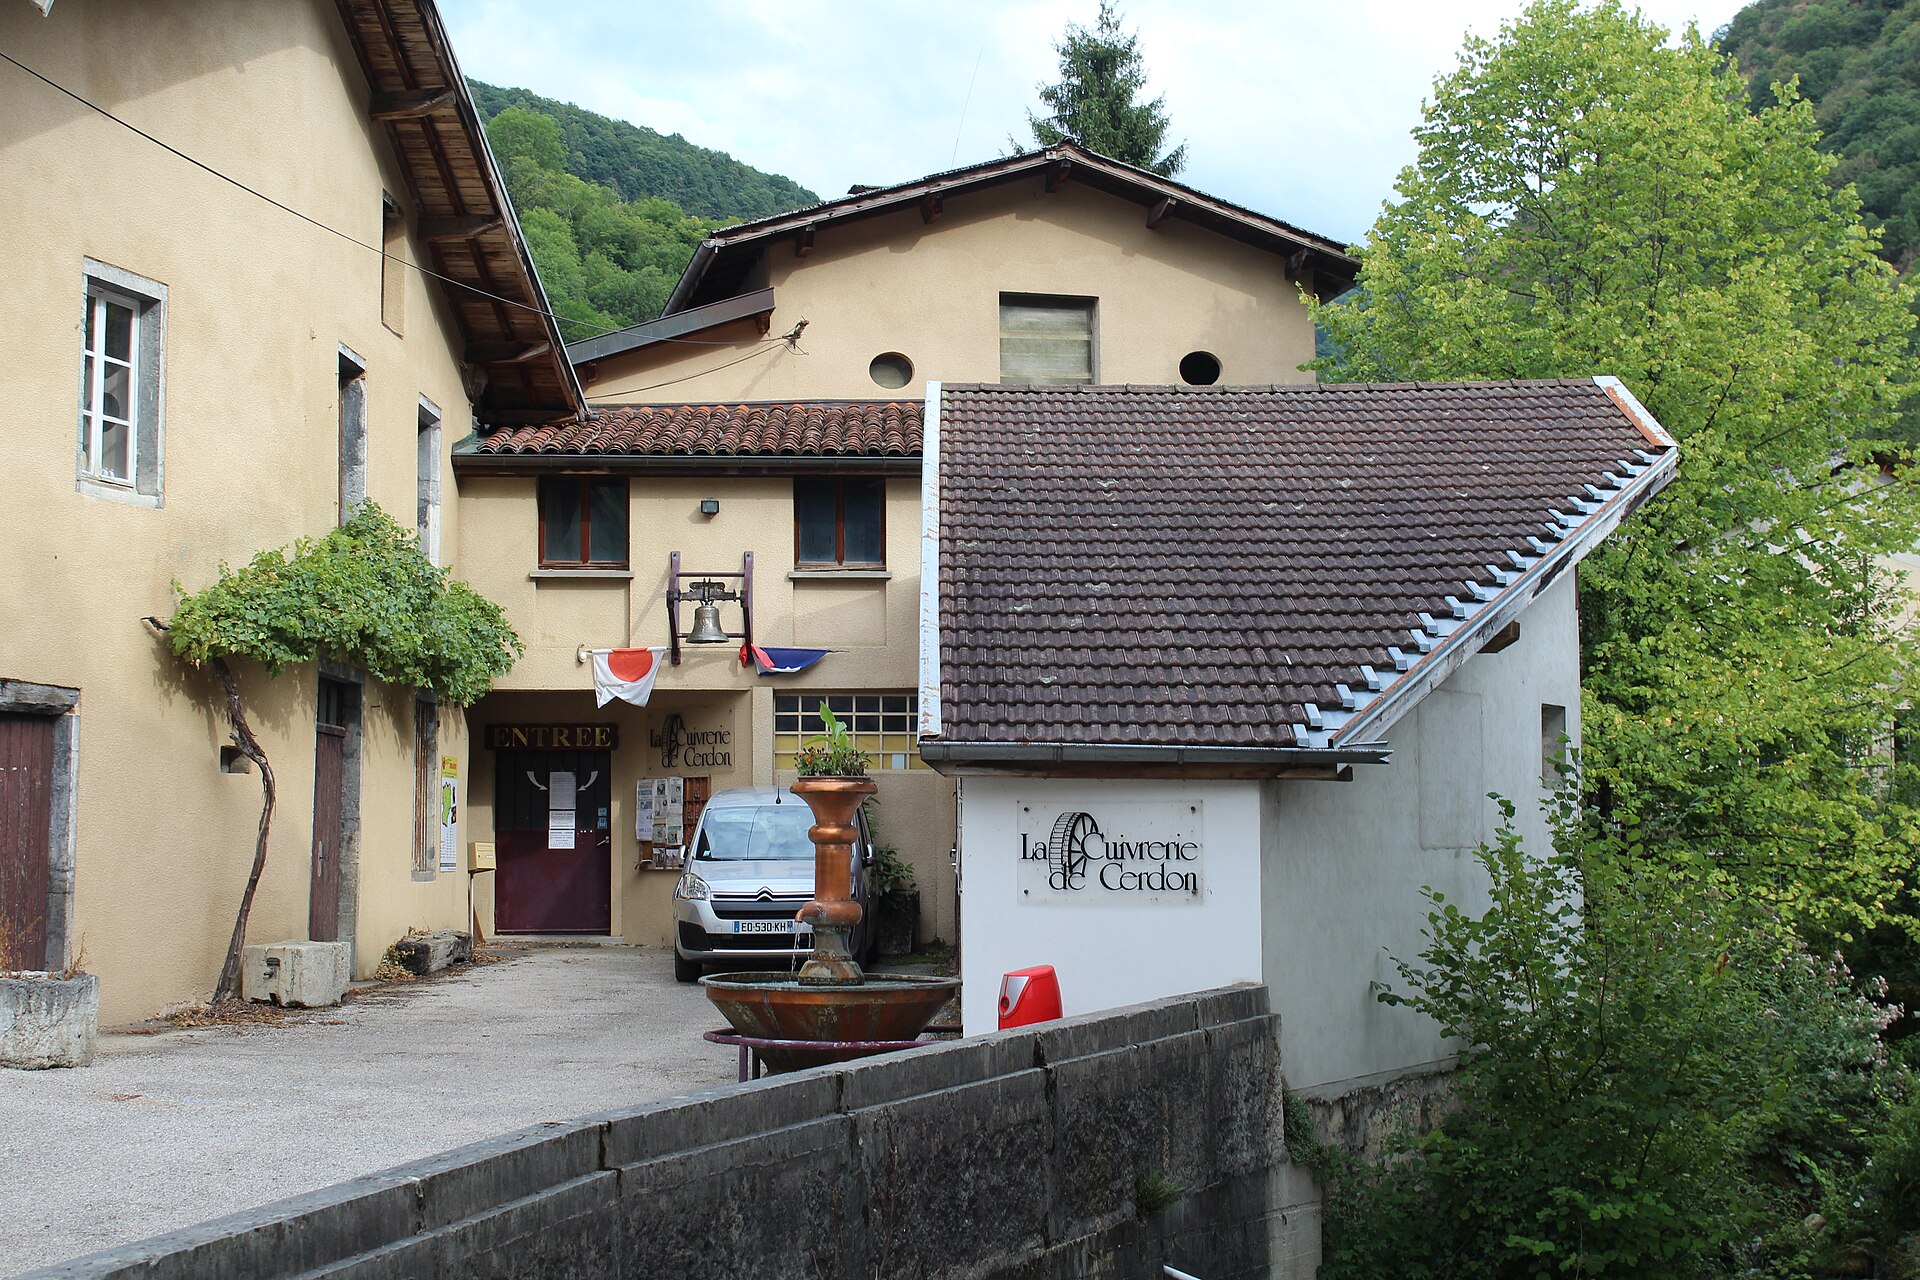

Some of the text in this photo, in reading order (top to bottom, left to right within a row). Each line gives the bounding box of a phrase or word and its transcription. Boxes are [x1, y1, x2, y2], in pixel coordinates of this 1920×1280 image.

[493, 727, 611, 747] ENTREE
[649, 724, 731, 747] La Cuivrerie
[661, 747, 732, 767] de Cerdon
[1021, 832, 1198, 861] La Cuivrerie
[1049, 862, 1198, 891] de Cerdon
